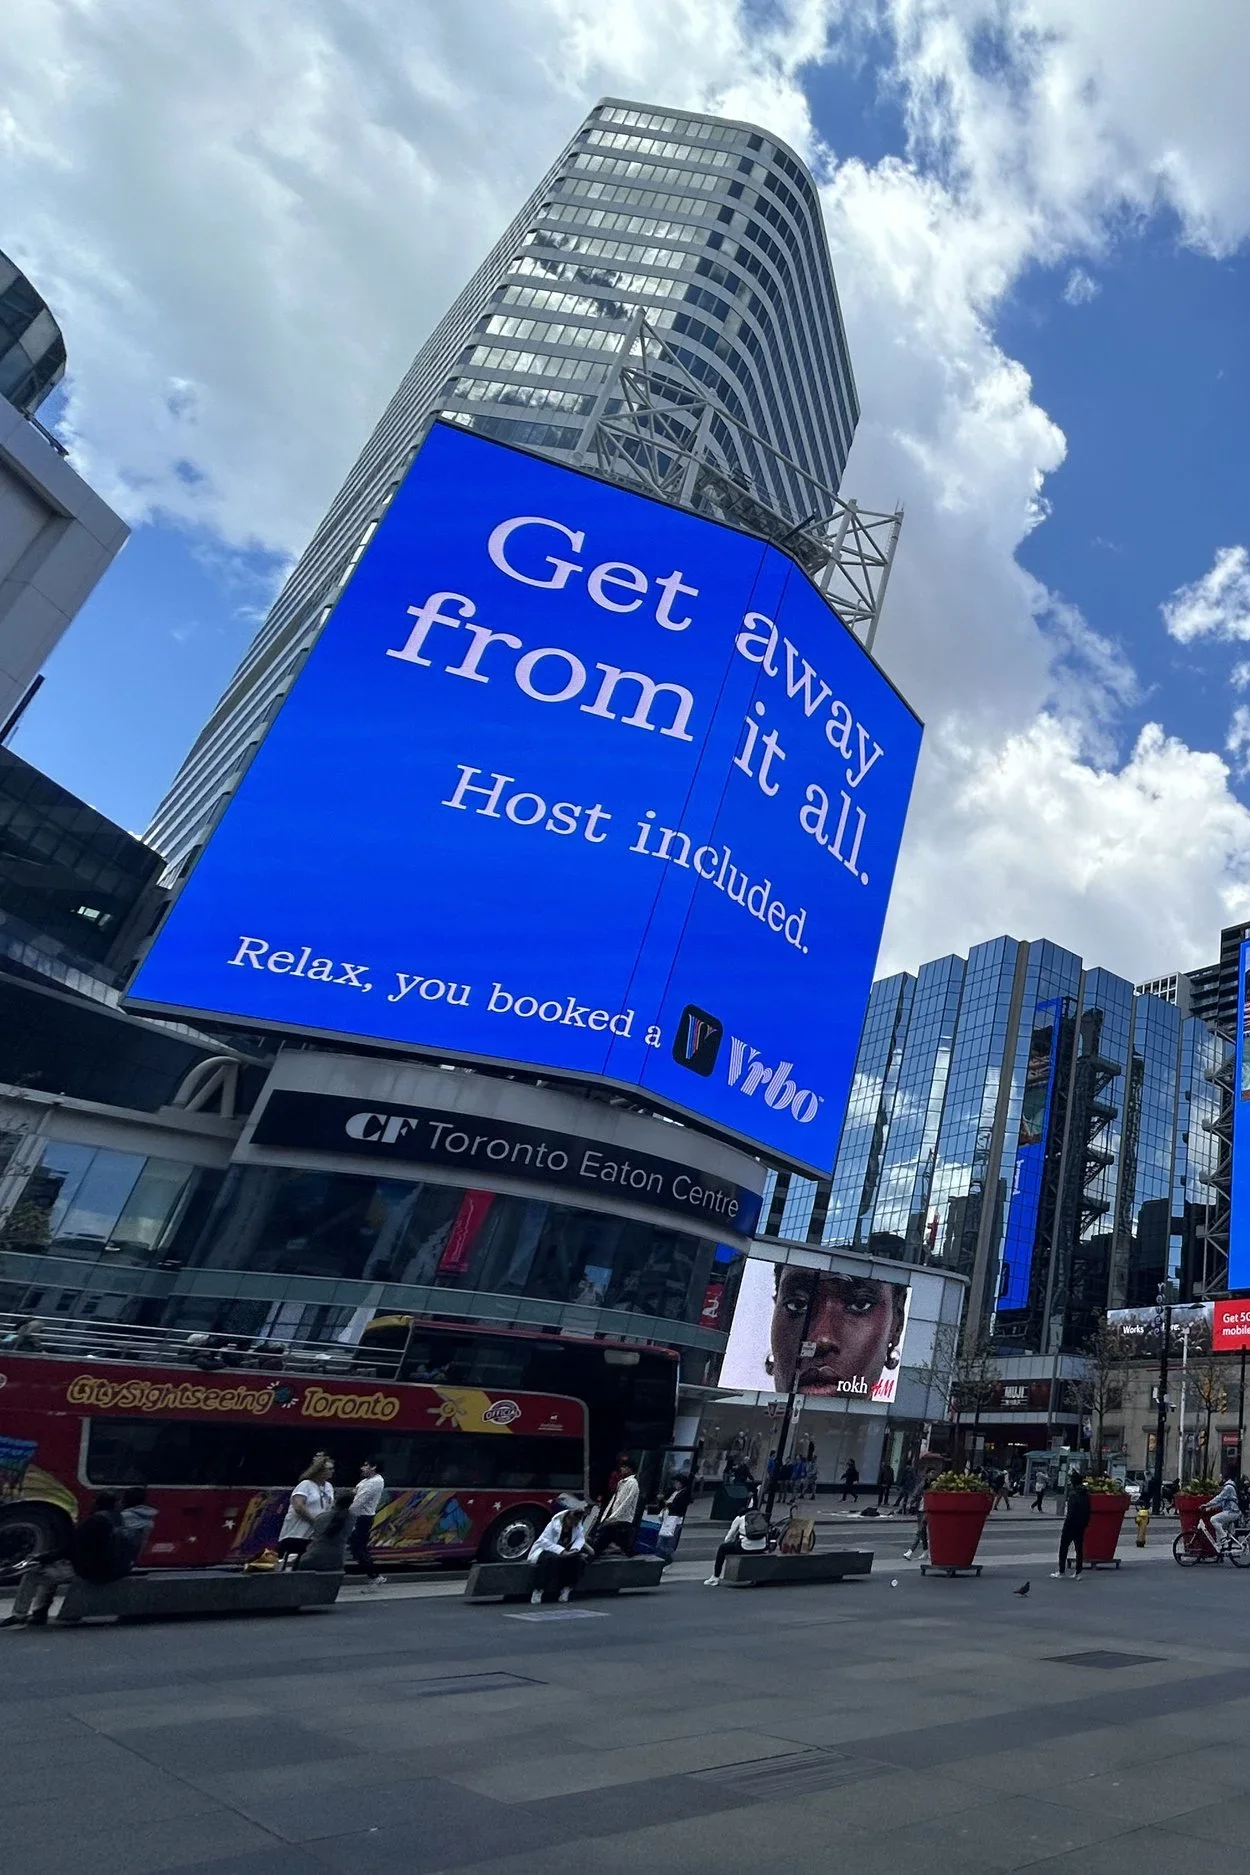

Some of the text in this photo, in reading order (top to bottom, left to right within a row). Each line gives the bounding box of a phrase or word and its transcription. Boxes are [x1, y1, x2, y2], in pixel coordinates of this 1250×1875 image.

[487, 516, 884, 789] Get away
[385, 590, 869, 886] from it all.
[442, 764, 809, 953] Host included.
[228, 936, 374, 992] Relax,
[387, 972, 470, 1006] you
[487, 982, 634, 1038] booked
[644, 1022, 662, 1047] a
[345, 1111, 740, 1220] CF Toronto Eaton Centre
[1122, 1325, 1144, 1334] Works
[1222, 1313, 1238, 1323] Get
[302, 1387, 399, 1420] Toronto
[836, 1375, 868, 1393] rokh
